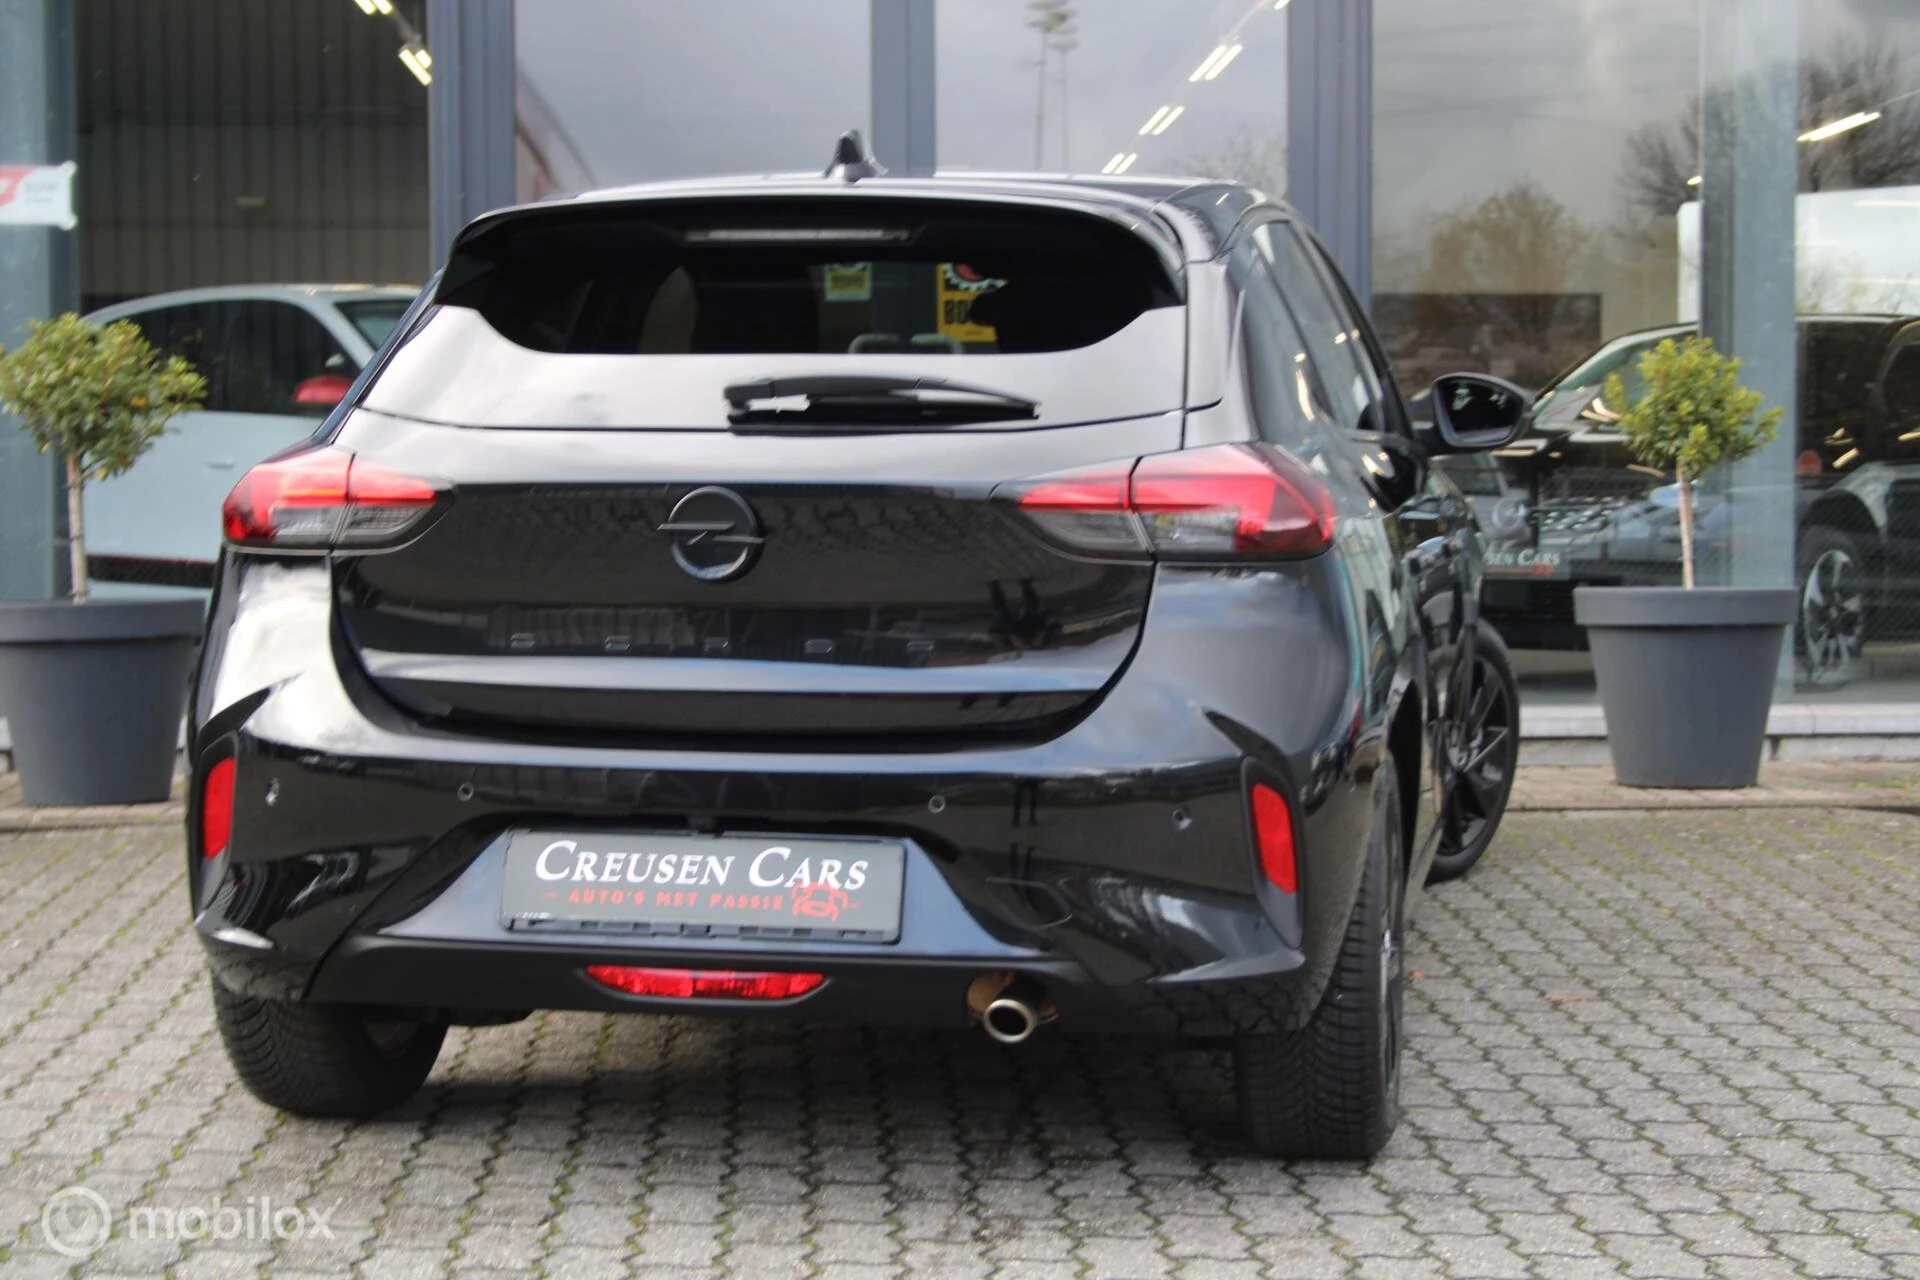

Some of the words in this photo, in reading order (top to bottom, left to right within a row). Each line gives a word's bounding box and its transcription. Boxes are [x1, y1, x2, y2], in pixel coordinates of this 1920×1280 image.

[534, 840, 735, 886] CREUSEN
[748, 847, 869, 890] CARS
[567, 887, 645, 906] AUTO'S
[655, 890, 698, 907] MET
[708, 892, 783, 910] PASSIE
